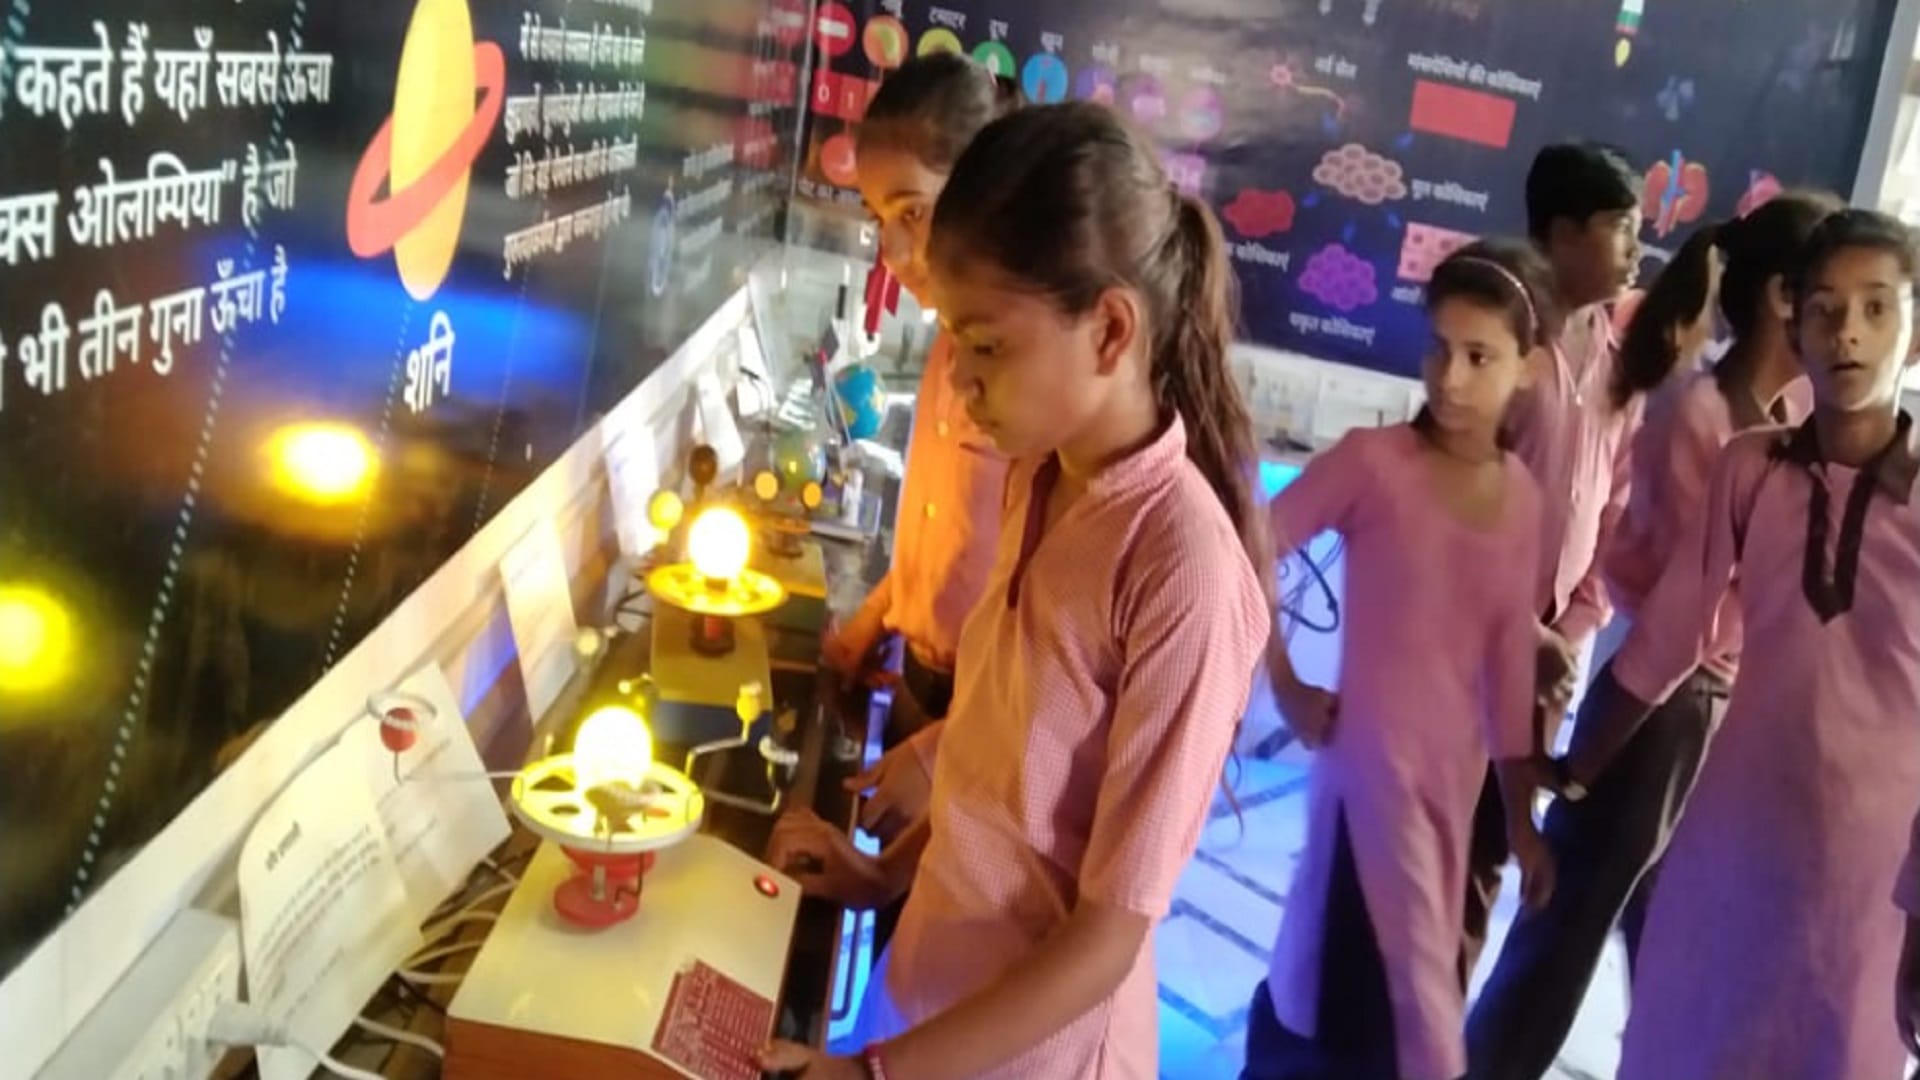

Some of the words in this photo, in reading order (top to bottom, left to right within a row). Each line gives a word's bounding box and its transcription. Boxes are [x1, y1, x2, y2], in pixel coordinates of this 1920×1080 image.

[14, 20, 113, 130] कहते
[120, 21, 148, 127] हैं
[153, 26, 213, 123] यहाँ
[215, 29, 281, 106] सबसे
[818, 85, 830, 103] 0
[242, 142, 261, 228] है
[264, 138, 298, 211] जो
[19, 302, 70, 395] भी
[78, 289, 143, 380] तीन
[149, 287, 205, 376] गुना
[210, 258, 266, 335] ऊँचा
[270, 244, 288, 325] है
[403, 309, 456, 416] शनि
